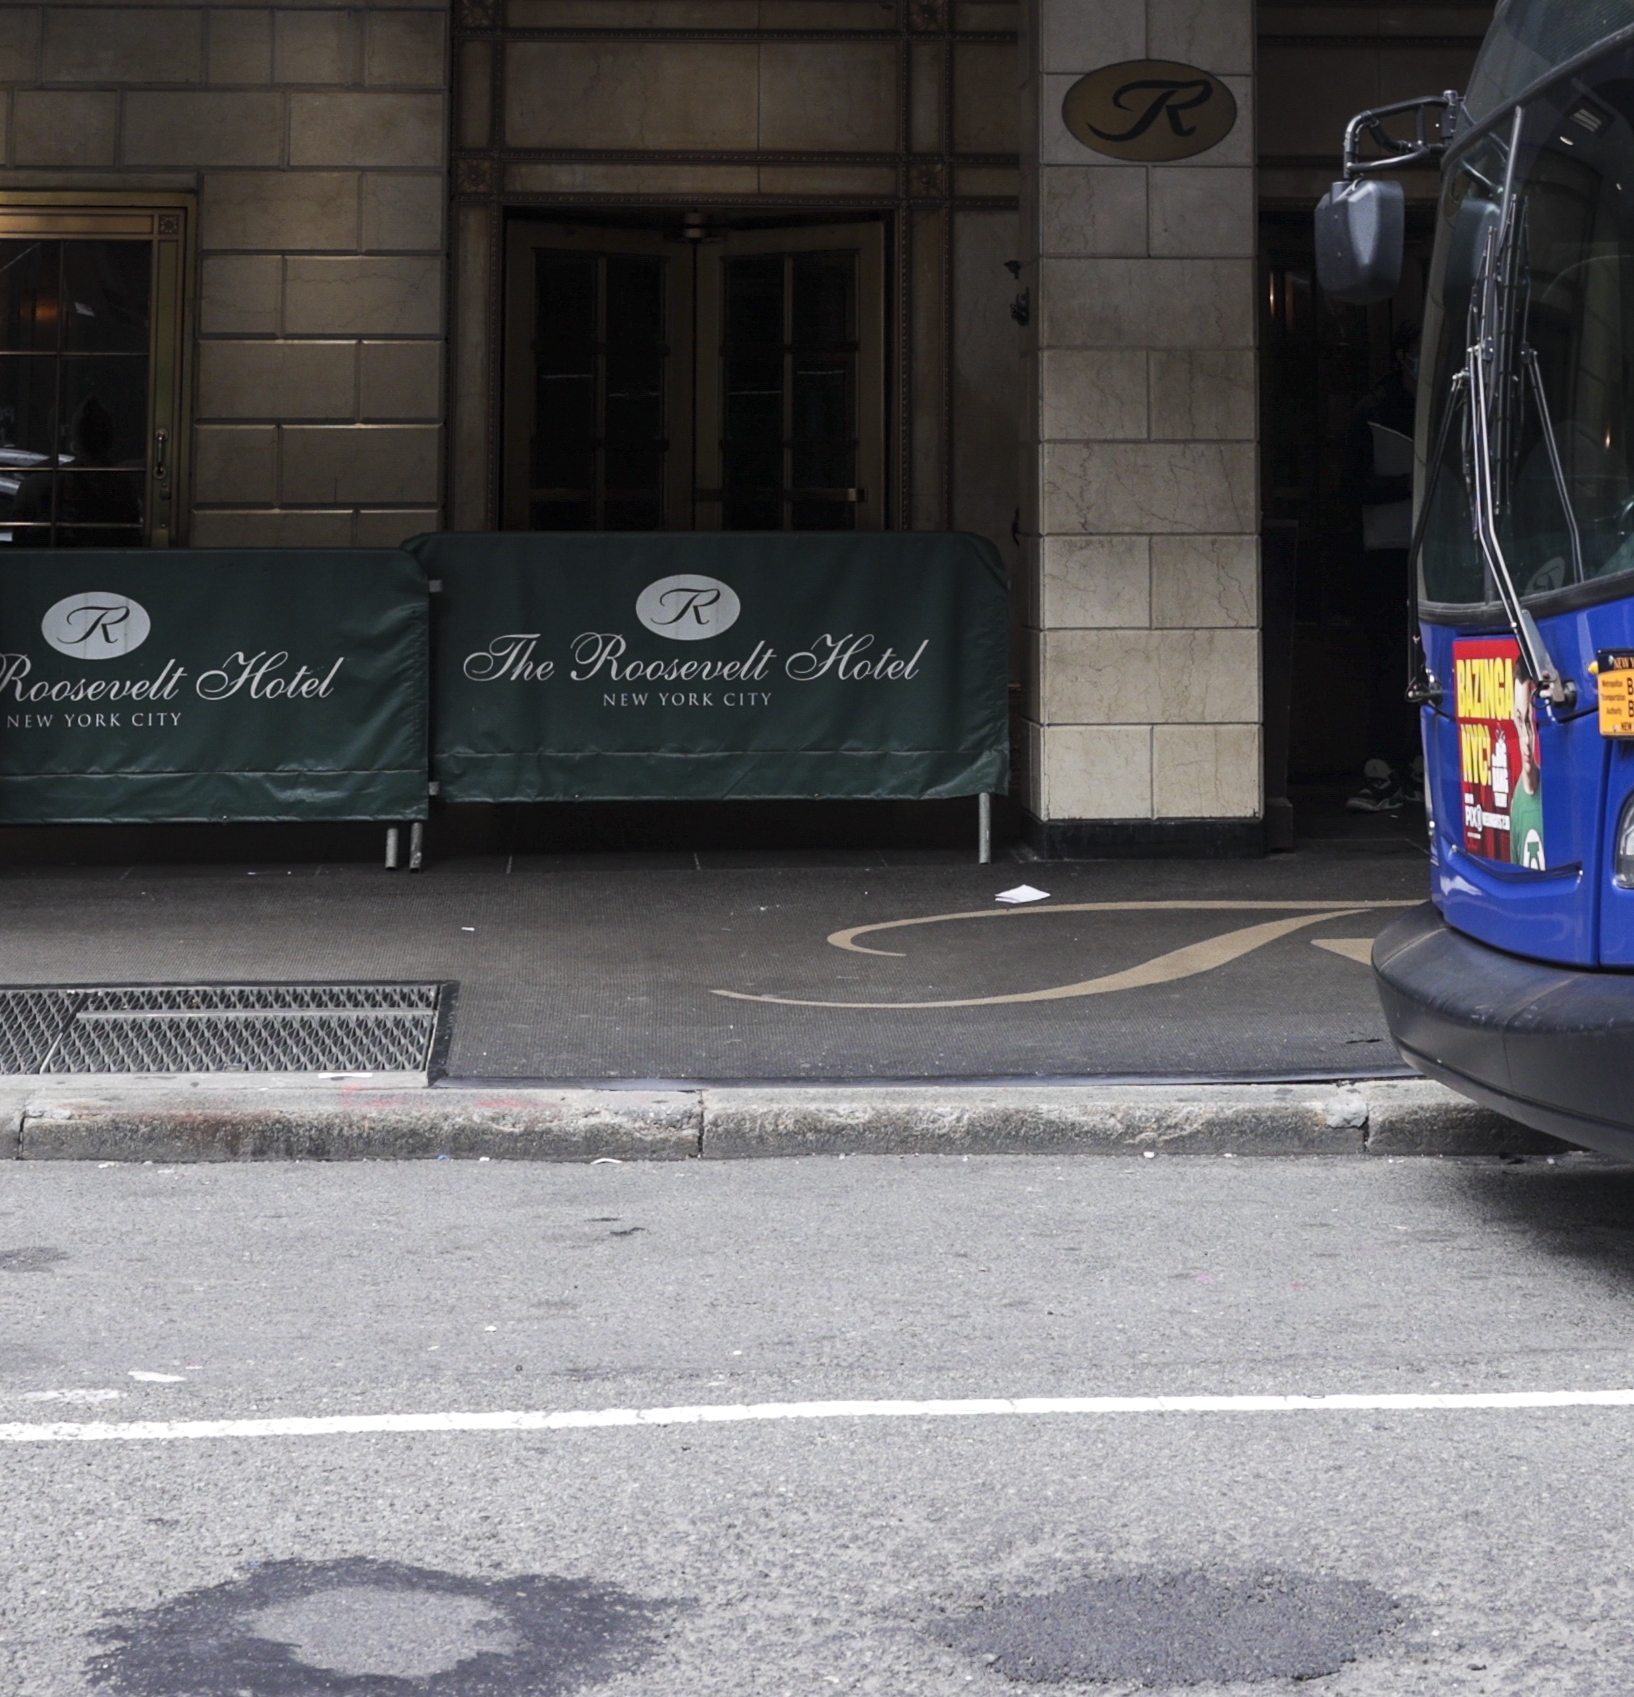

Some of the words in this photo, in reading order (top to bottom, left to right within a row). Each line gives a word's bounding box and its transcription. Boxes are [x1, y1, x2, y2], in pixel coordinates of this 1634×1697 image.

[56, 605, 131, 645] R
[650, 587, 722, 626] R
[195, 650, 345, 700] Hotel
[463, 633, 555, 682] The
[570, 631, 777, 682] Roosevelt
[785, 633, 930, 681] Hotel
[1614, 657, 1629, 669] NEW
[603, 693, 650, 707] NEW
[659, 692, 714, 706] YORK
[723, 692, 773, 706] CITY
[1456, 657, 1515, 721] BAZINGA
[7, 714, 54, 729] NEW
[64, 713, 122, 728] YORK
[132, 712, 182, 727] CITY
[1621, 723, 1632, 731] NEW
[1460, 723, 1492, 786] NYC!
